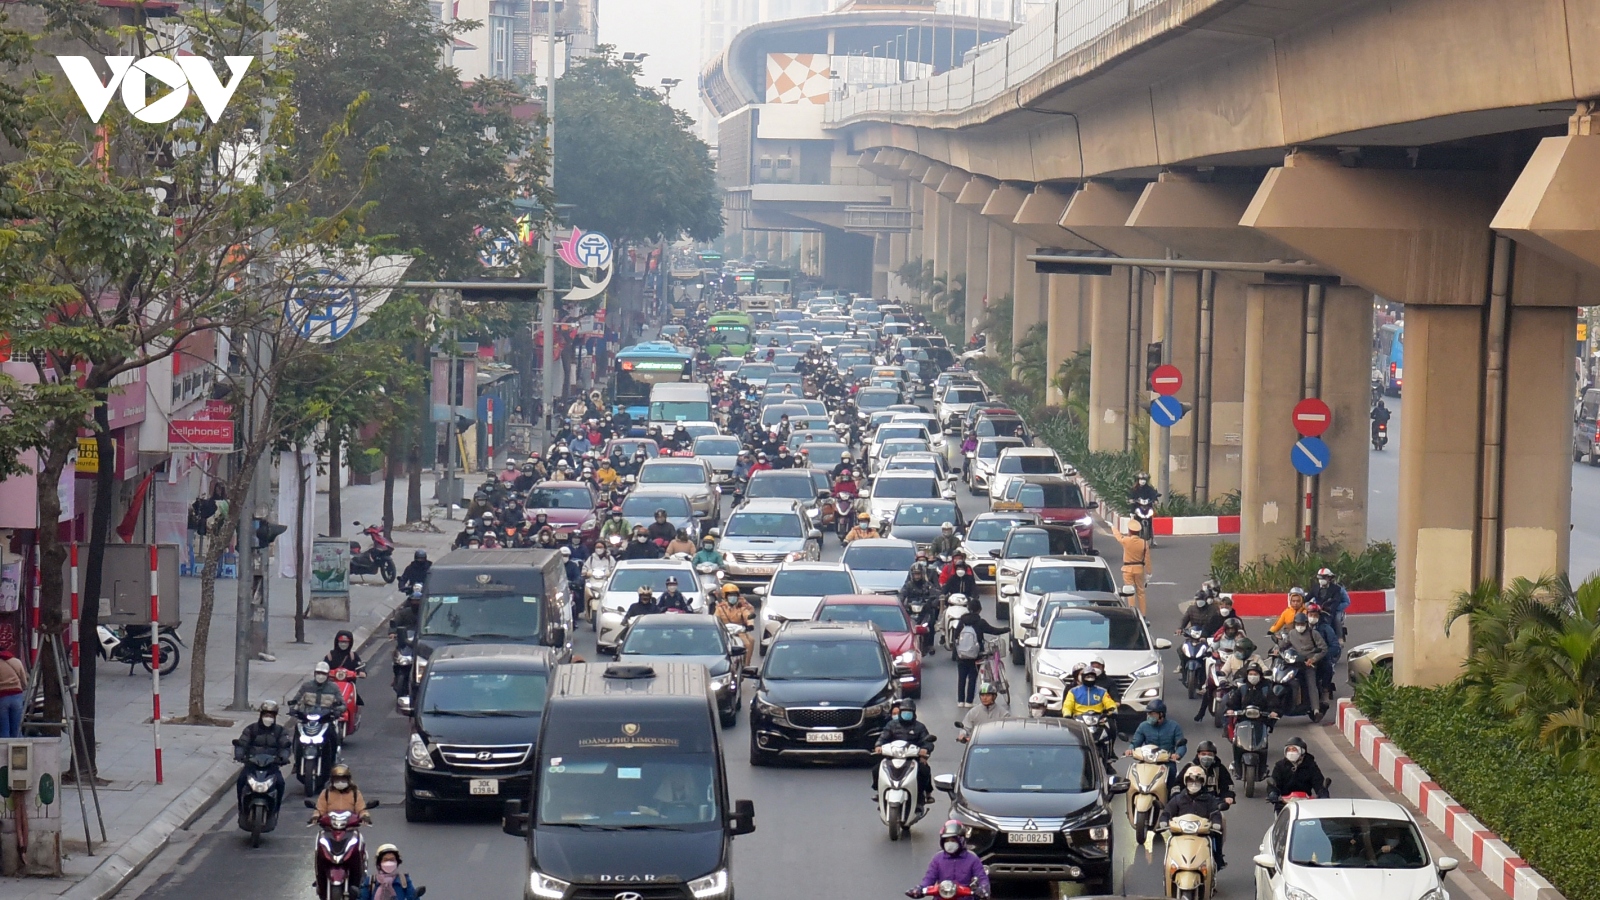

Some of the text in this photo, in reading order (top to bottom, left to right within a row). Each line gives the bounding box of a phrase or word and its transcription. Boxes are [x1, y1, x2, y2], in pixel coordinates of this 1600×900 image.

[579, 736, 610, 745] HOÀNG
[631, 737, 679, 745] LIMOUSINE
[1009, 833, 1052, 843] 30G-082.51
